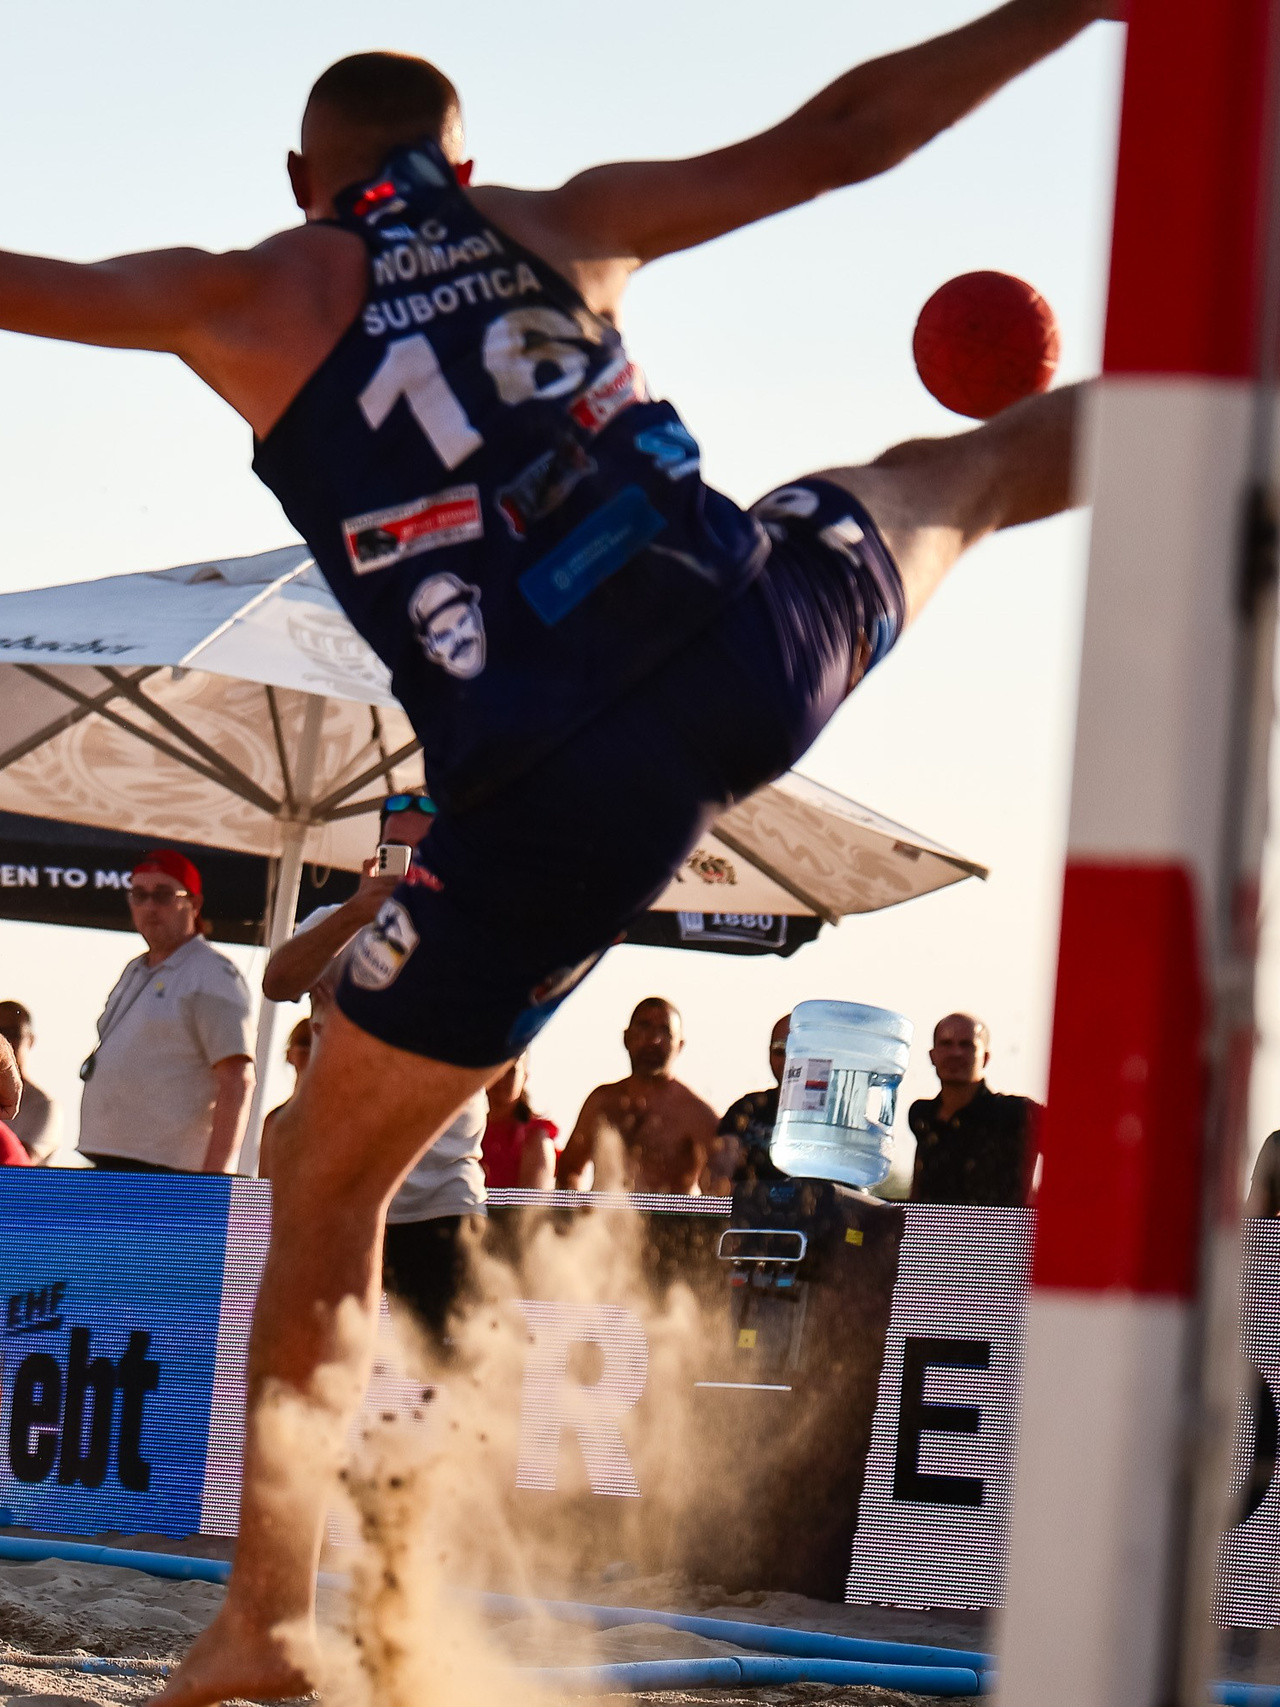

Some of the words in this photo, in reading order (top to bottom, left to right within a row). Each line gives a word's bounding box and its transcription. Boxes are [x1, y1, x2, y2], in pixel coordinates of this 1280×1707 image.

[363, 263, 542, 336] SUBOTICA
[44, 866, 87, 889] TO
[10, 1327, 159, 1492] ebt
